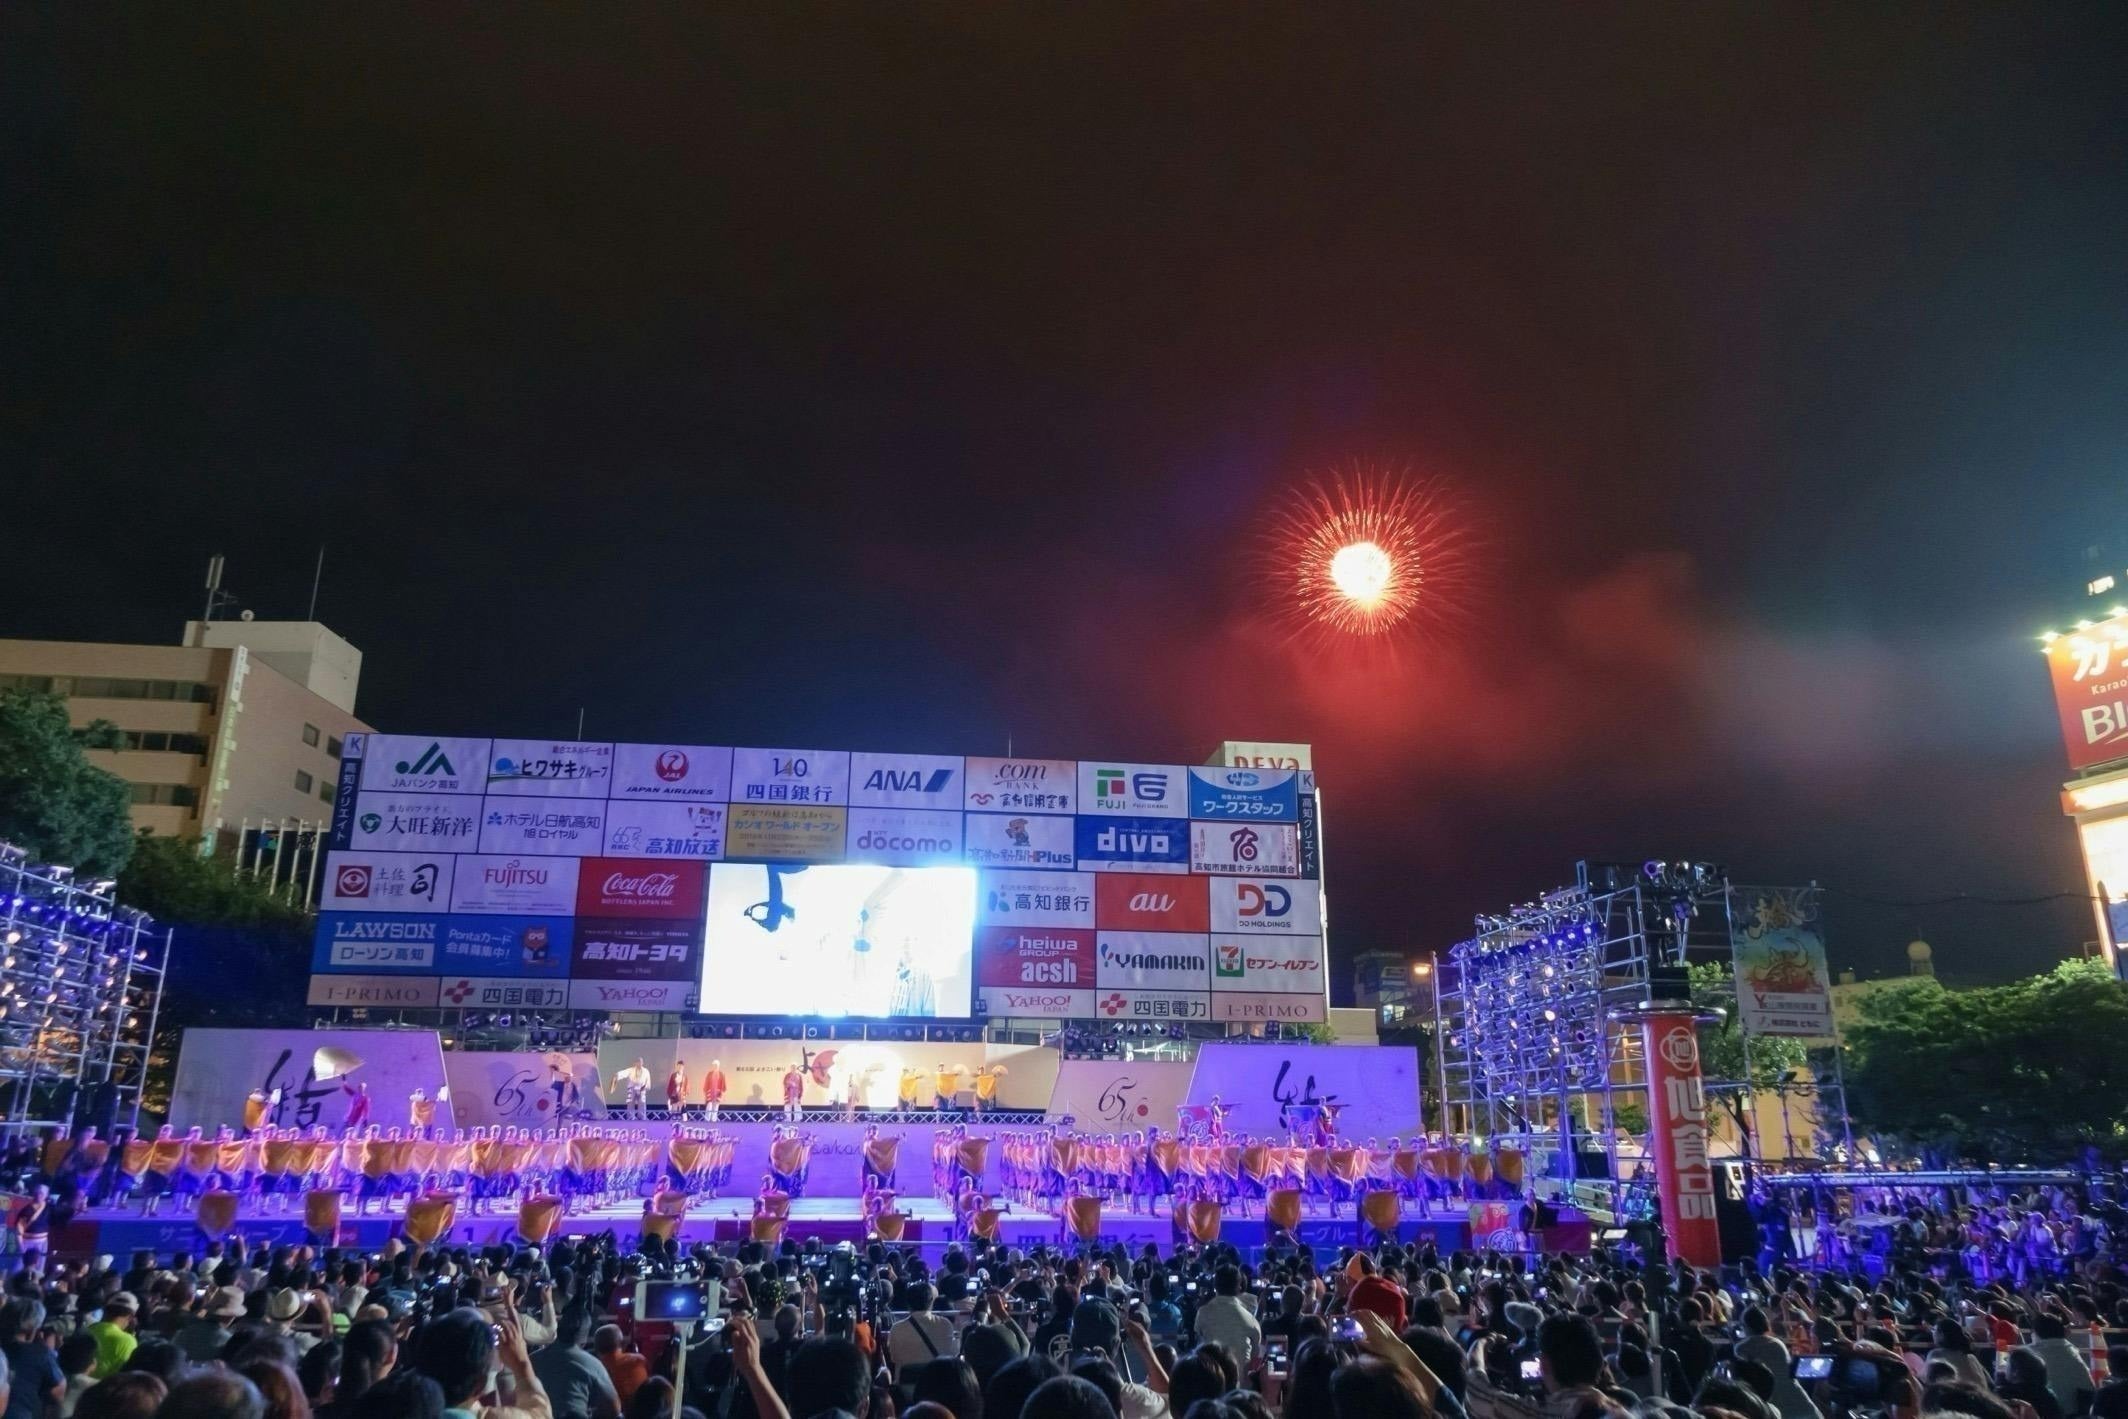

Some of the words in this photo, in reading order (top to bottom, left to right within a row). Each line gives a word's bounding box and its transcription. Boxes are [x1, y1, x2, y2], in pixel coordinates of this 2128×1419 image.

[351, 737, 362, 752] K
[521, 759, 609, 779] ヒワサキグループ
[392, 778, 460, 791] JAバンク高知
[864, 769, 922, 792] ANA
[1006, 779, 1040, 790] BANK
[1302, 774, 1313, 788] K
[625, 785, 660, 794] JAPAN
[663, 787, 714, 796] AIRLINES
[746, 784, 833, 803] 四国銀行
[335, 762, 358, 842] 高知クリエイト
[1097, 800, 1126, 810] FUJI
[1203, 801, 1284, 816] ワークスタッフ
[387, 815, 473, 837] 大旺新洋
[504, 813, 601, 830] ホテル日航高知
[735, 819, 762, 829] カシオ
[767, 820, 801, 830] ワールド
[803, 822, 841, 832] オープン
[524, 828, 579, 840] 旭ロイヤル
[857, 830, 953, 853] docomo
[1097, 827, 1169, 853] divo
[1301, 798, 1316, 872] 高知クリエイト
[645, 838, 721, 855] 高知放送
[376, 867, 406, 882] 土佐
[1015, 893, 1091, 912] 高知銀行
[1129, 892, 1177, 913] au
[1238, 883, 1292, 917] DD
[335, 921, 437, 940] LAWSON
[1250, 921, 1292, 929] HOLDINGS
[448, 928, 513, 945] Pontaカード
[1019, 935, 1078, 951] heiwa
[340, 946, 425, 962] ローソン高知
[582, 942, 690, 963] 高知トヨタ
[1021, 957, 1077, 984] acsh
[1116, 953, 1205, 971] YAMAKIN
[327, 987, 421, 1002] I-PRIMO
[482, 987, 564, 1006] 四国電力
[1004, 994, 1071, 1009] YAHOO!
[1134, 1000, 1207, 1018] 四国電力
[1227, 1004, 1309, 1018] I-PRIMO
[1664, 1076, 1716, 1220] 旭食品
